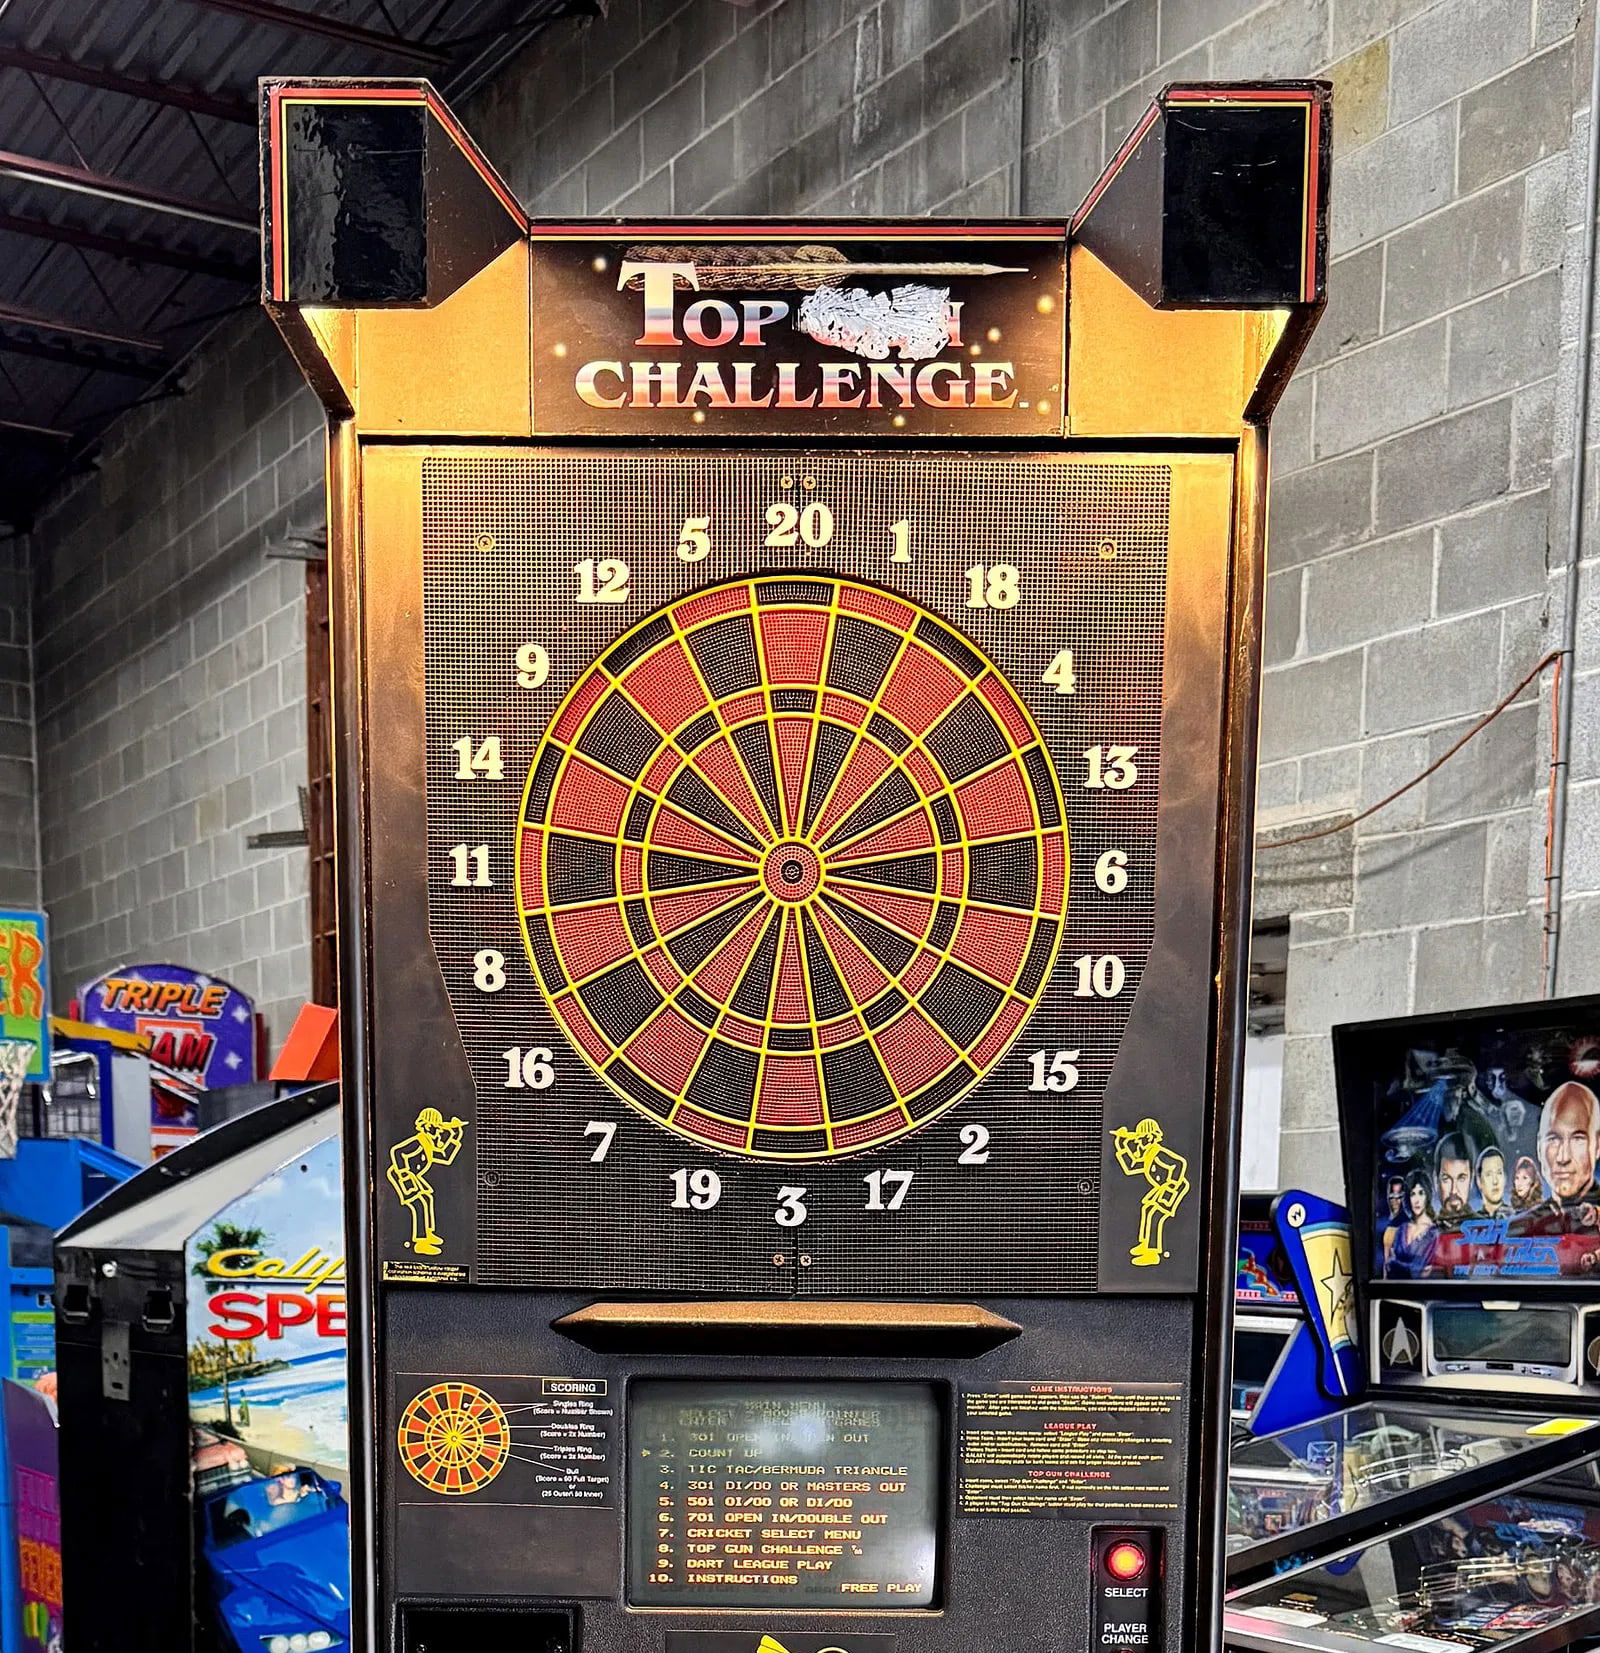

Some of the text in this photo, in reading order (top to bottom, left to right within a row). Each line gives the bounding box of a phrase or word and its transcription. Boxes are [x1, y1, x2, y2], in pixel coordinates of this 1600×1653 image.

[616, 261, 789, 347] TOP
[574, 361, 1019, 409] CHALLENGE
[677, 517, 711, 562] 5
[765, 503, 834, 548] 20
[890, 520, 911, 563] 1
[573, 559, 631, 603] 12
[965, 564, 1021, 610] 18
[516, 644, 551, 690] 9
[1042, 650, 1077, 694] 4
[452, 737, 505, 781] 14
[1083, 745, 1139, 791] 13
[449, 845, 494, 888] 11
[1095, 851, 1129, 895] 6
[474, 950, 507, 993] 8
[1074, 954, 1126, 999] 10
[103, 979, 227, 1016] TRIPLE
[145, 1030, 214, 1072] AM
[503, 1047, 556, 1090] 16
[1028, 1051, 1081, 1093] 15
[583, 1121, 618, 1163] 7
[959, 1124, 991, 1165] 2
[670, 1170, 722, 1211] 19
[775, 1186, 808, 1228] 3
[865, 1171, 914, 1211] 17
[551, 1383, 596, 1392] SCORING
[1030, 1385, 1053, 1393] GAME
[689, 1449, 733, 1458] COUNT
[744, 1449, 761, 1458] UP
[844, 1434, 869, 1443] OUT
[659, 1481, 674, 1490] 4.
[688, 1481, 714, 1490] 301
[780, 1482, 798, 1491] OR
[807, 1482, 871, 1491] MASTERS
[879, 1483, 906, 1492] OUT
[660, 1465, 908, 1475] 3. TIC TAC/BERMUDA TRIANGLE
[659, 1497, 674, 1507] 5.
[687, 1497, 714, 1507] 501
[780, 1497, 798, 1507] OR
[659, 1513, 888, 1524] 6. 701 OPEN IN/DOUBLE OUT
[658, 1529, 861, 1539] 7. CRICKET SELECT MENU
[658, 1544, 674, 1554] 8.
[687, 1544, 715, 1554] TOP
[725, 1544, 753, 1554] GUN
[761, 1545, 843, 1555] CHALLENGE
[649, 1574, 798, 1584] 10. INSTRUCTIONS
[657, 1560, 833, 1570] 9. DART LEAGUE PLAY
[841, 1583, 878, 1593] FREE
[886, 1583, 922, 1593] PLAY
[1104, 1588, 1148, 1597] SELECT
[1101, 1634, 1149, 1644] CHANGE
[1104, 1623, 1147, 1633] PLAYER
